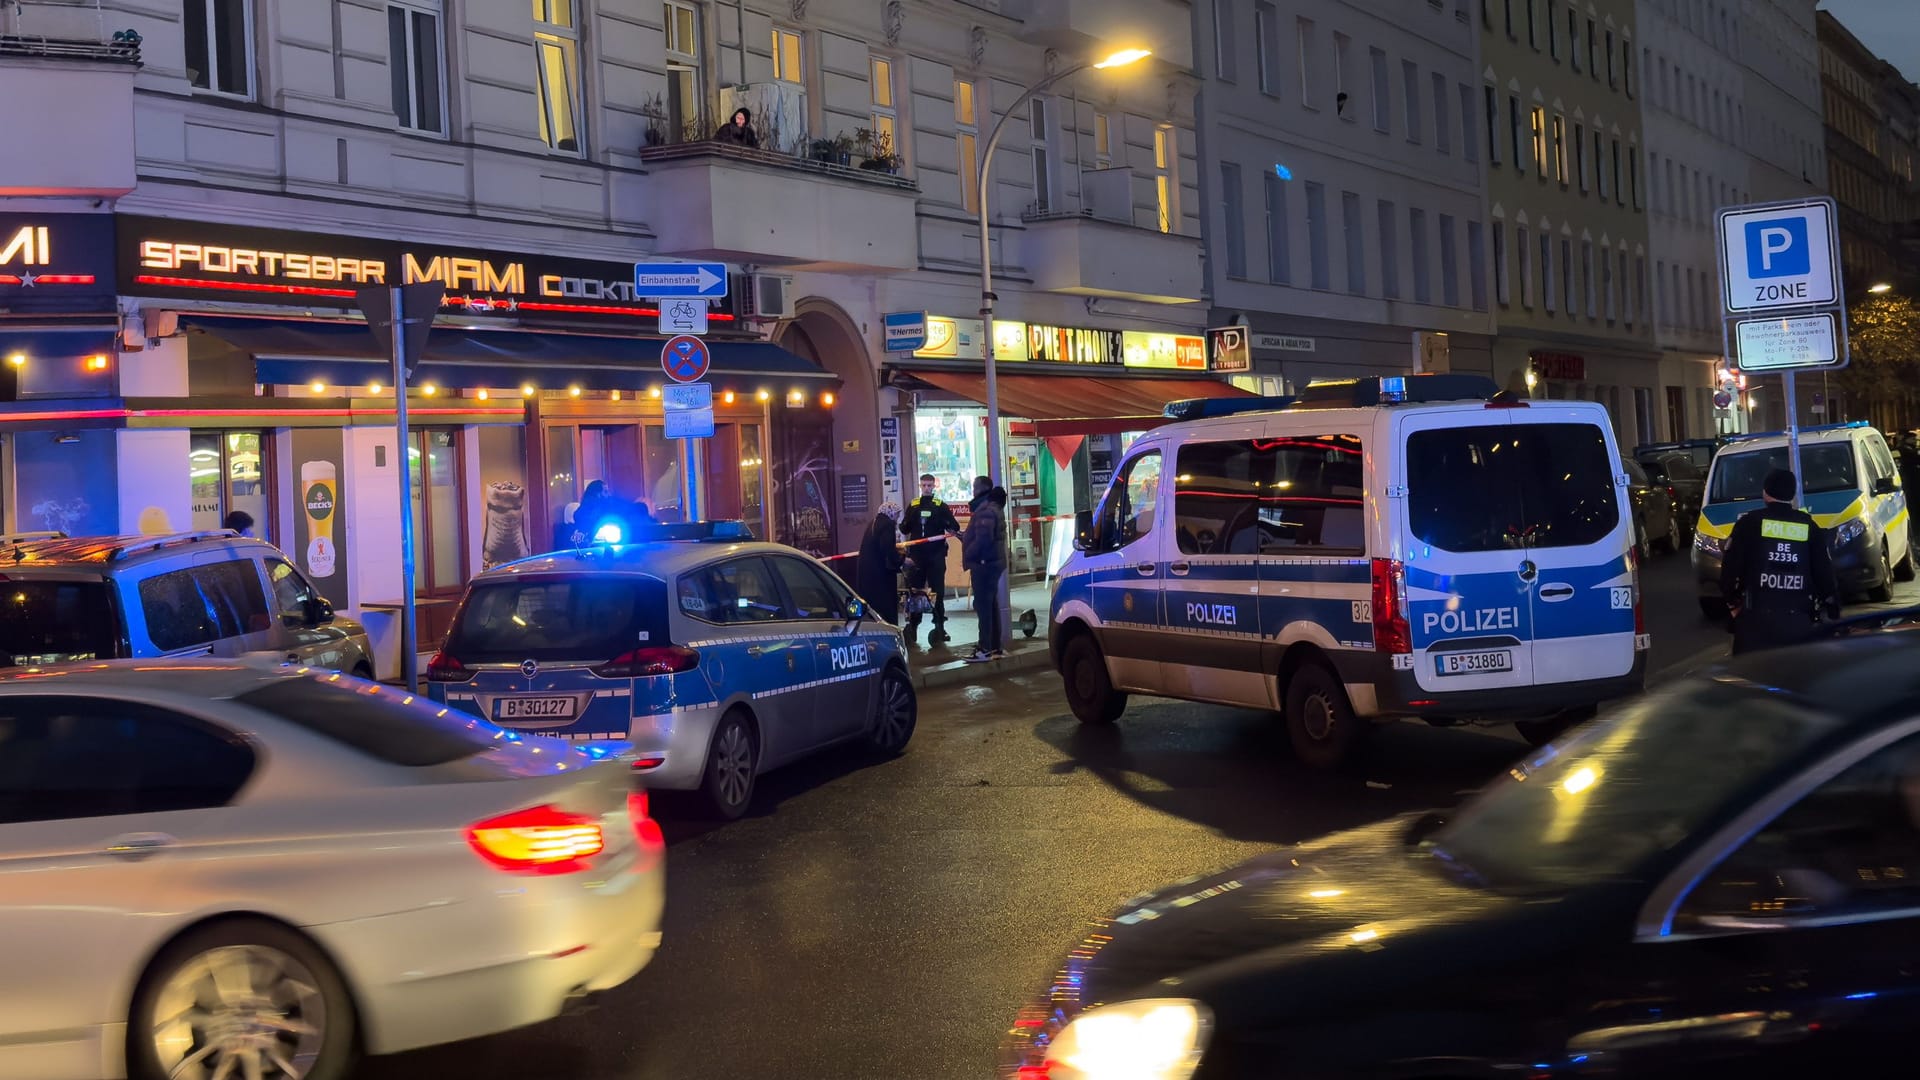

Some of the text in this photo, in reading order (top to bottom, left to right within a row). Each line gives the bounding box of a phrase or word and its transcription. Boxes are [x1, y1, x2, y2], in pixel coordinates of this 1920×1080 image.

[1760, 227, 1793, 270] P
[140, 240, 385, 284] SPORTSBAR
[401, 252, 525, 294] MIAMI
[641, 275, 700, 285] Einbahnstraße
[1755, 282, 1807, 301] ZONE
[896, 328, 923, 336] Hermes
[1043, 326, 1073, 362] NEXT
[1076, 328, 1114, 364] PHONE
[1115, 333, 1123, 362] 2
[308, 500, 332, 510] BECK'S
[1764, 522, 1808, 539] POLIZEI
[1777, 543, 1791, 552] BE
[1768, 552, 1798, 562] 32336
[1760, 573, 1803, 590] POLIZEI
[1612, 588, 1631, 608] 32
[1187, 603, 1237, 625] POLIZEI
[1353, 601, 1371, 621] 32
[1423, 606, 1519, 635] POLIZEI
[831, 643, 869, 671] POLIZEI
[1450, 653, 1505, 670] B 31880
[507, 700, 567, 716] B 30127
